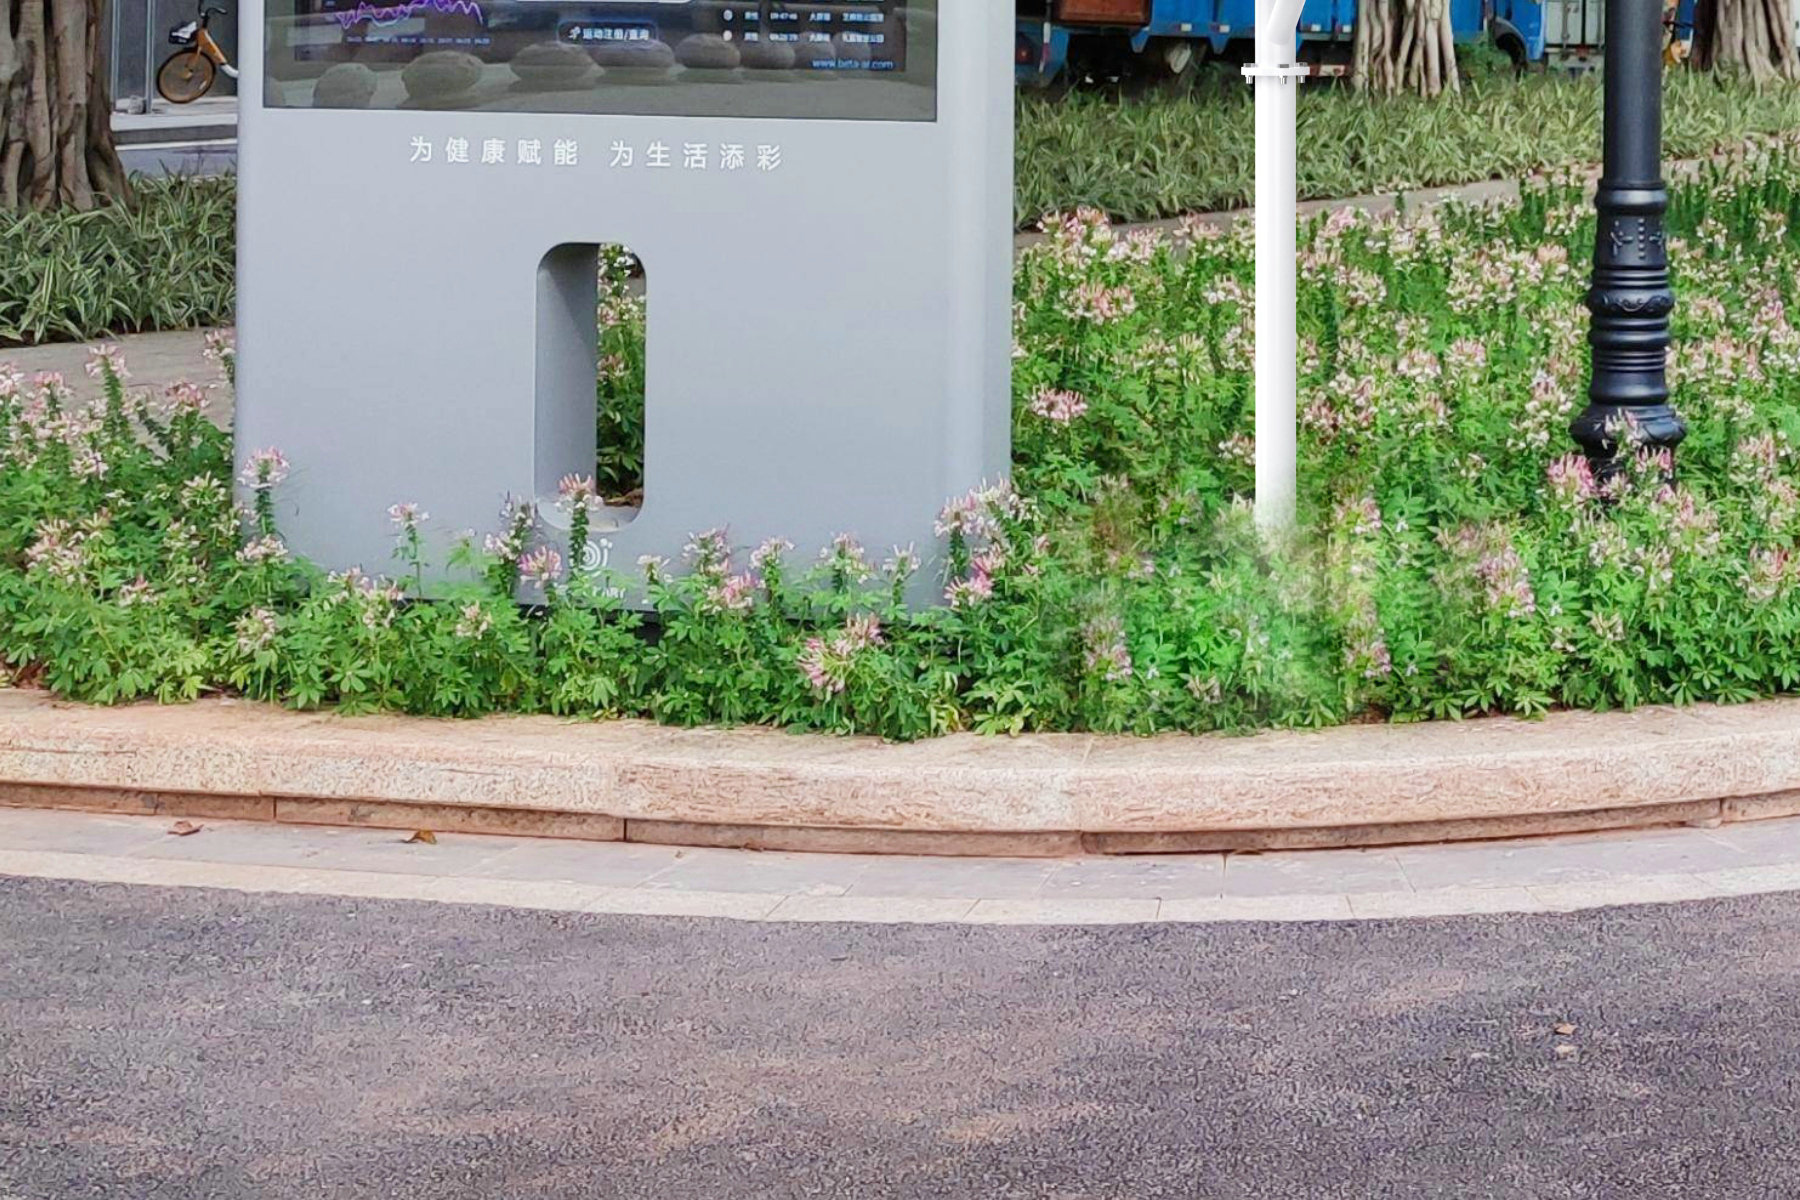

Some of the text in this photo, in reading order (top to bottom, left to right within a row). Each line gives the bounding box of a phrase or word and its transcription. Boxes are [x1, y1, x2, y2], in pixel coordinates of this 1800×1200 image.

[410, 136, 785, 172] 为健康赋能 为生活添彩
